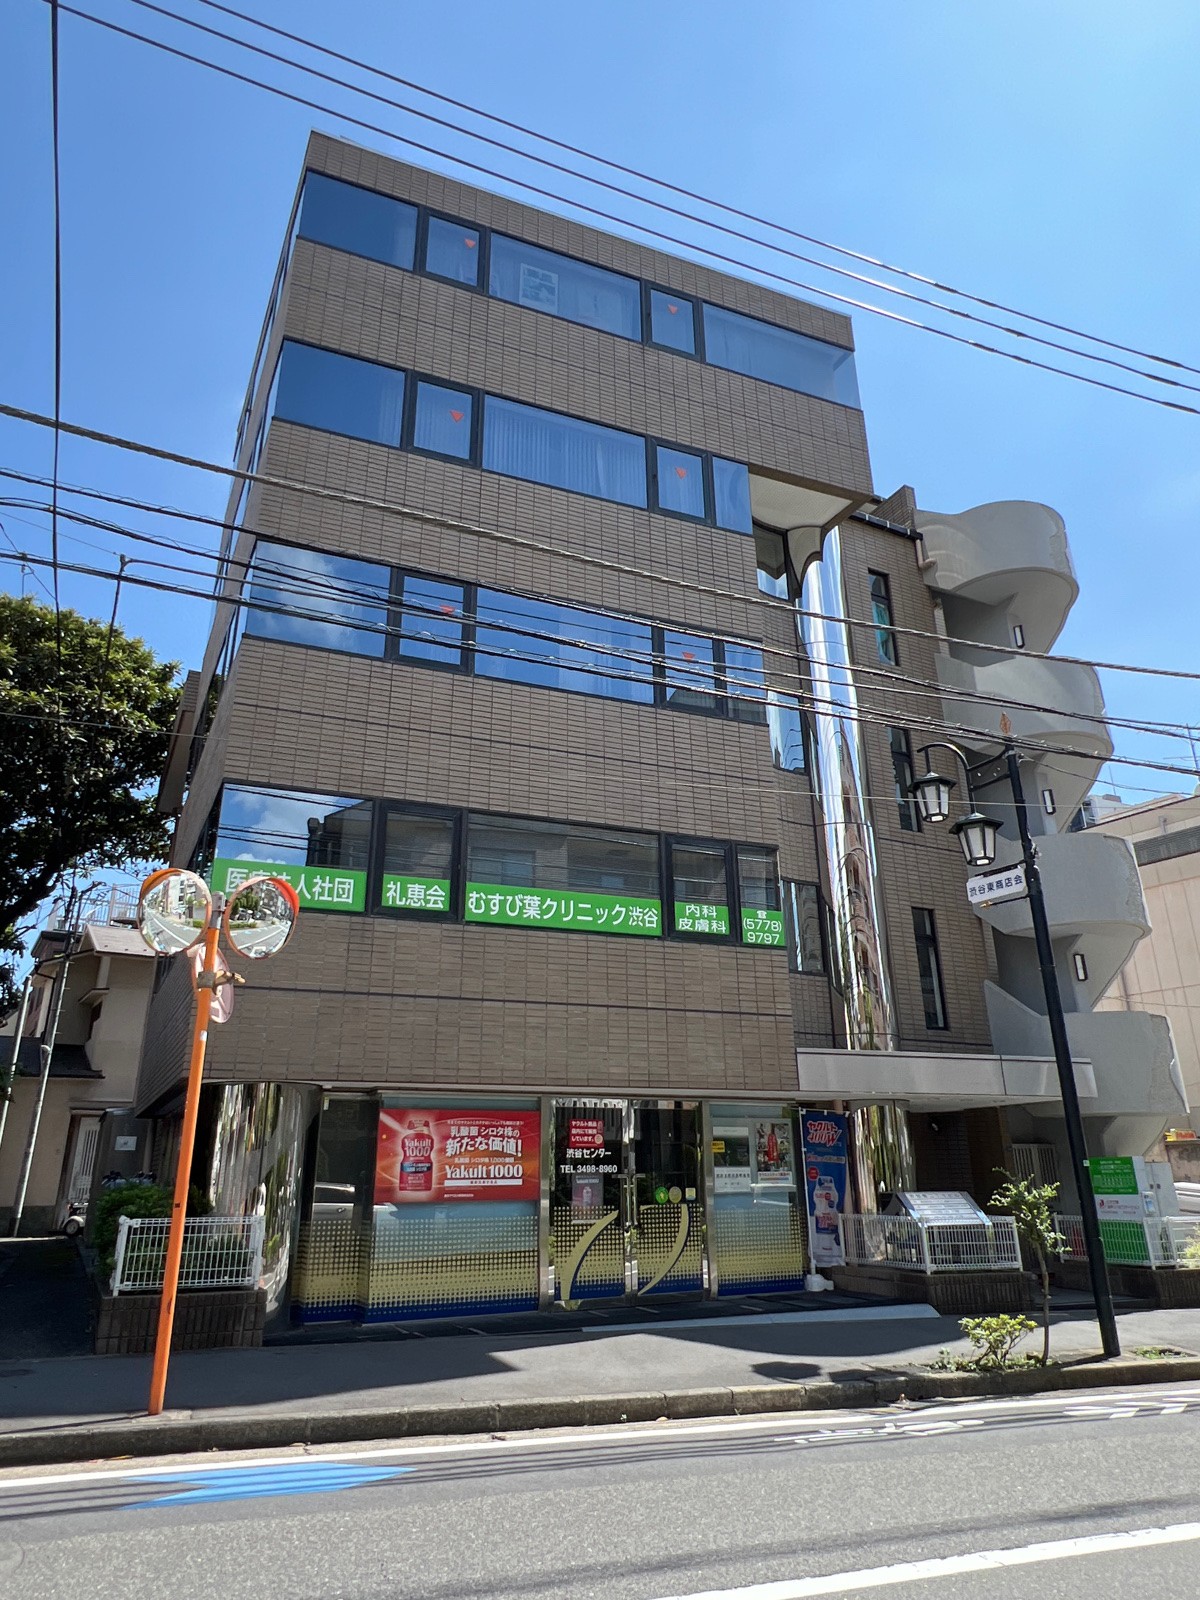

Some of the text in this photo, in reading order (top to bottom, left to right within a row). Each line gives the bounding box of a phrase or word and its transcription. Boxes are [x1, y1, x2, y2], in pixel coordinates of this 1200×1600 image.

[968, 874, 1023, 897] 渋谷東商店会
[386, 881, 446, 909] 礼恵会
[468, 890, 658, 928] むすび葉クリニック渋谷
[685, 904, 718, 919] 内科
[678, 918, 727, 934] 皮膚科
[743, 918, 782, 932] (5778)
[747, 932, 780, 945] 9797
[404, 1147, 431, 1157] 1000
[566, 1148, 612, 1159] 渋谷センター
[445, 1164, 488, 1179] Yakult
[488, 1164, 523, 1178] 1000
[560, 1164, 618, 1174] TEL 3498-8960
